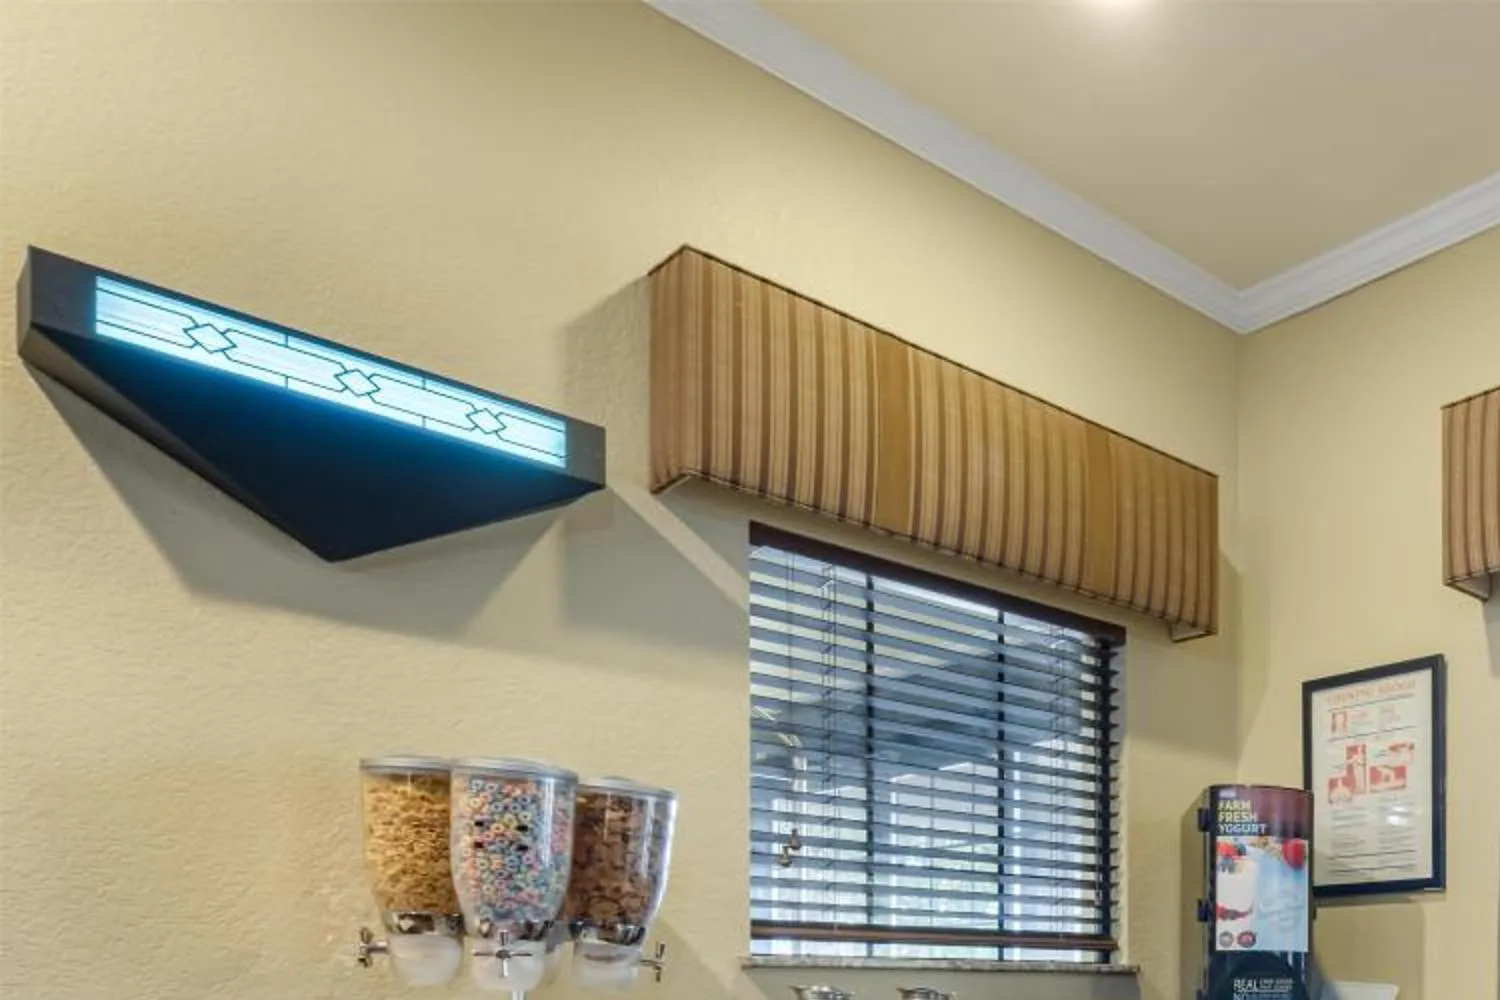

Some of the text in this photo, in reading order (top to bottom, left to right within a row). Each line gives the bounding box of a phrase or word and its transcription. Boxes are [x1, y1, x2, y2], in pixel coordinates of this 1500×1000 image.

[1218, 800, 1251, 811] FARM
[1218, 811, 1258, 823] FRESH
[1218, 823, 1267, 834] YOGURT
[1233, 977, 1257, 992] REAL
